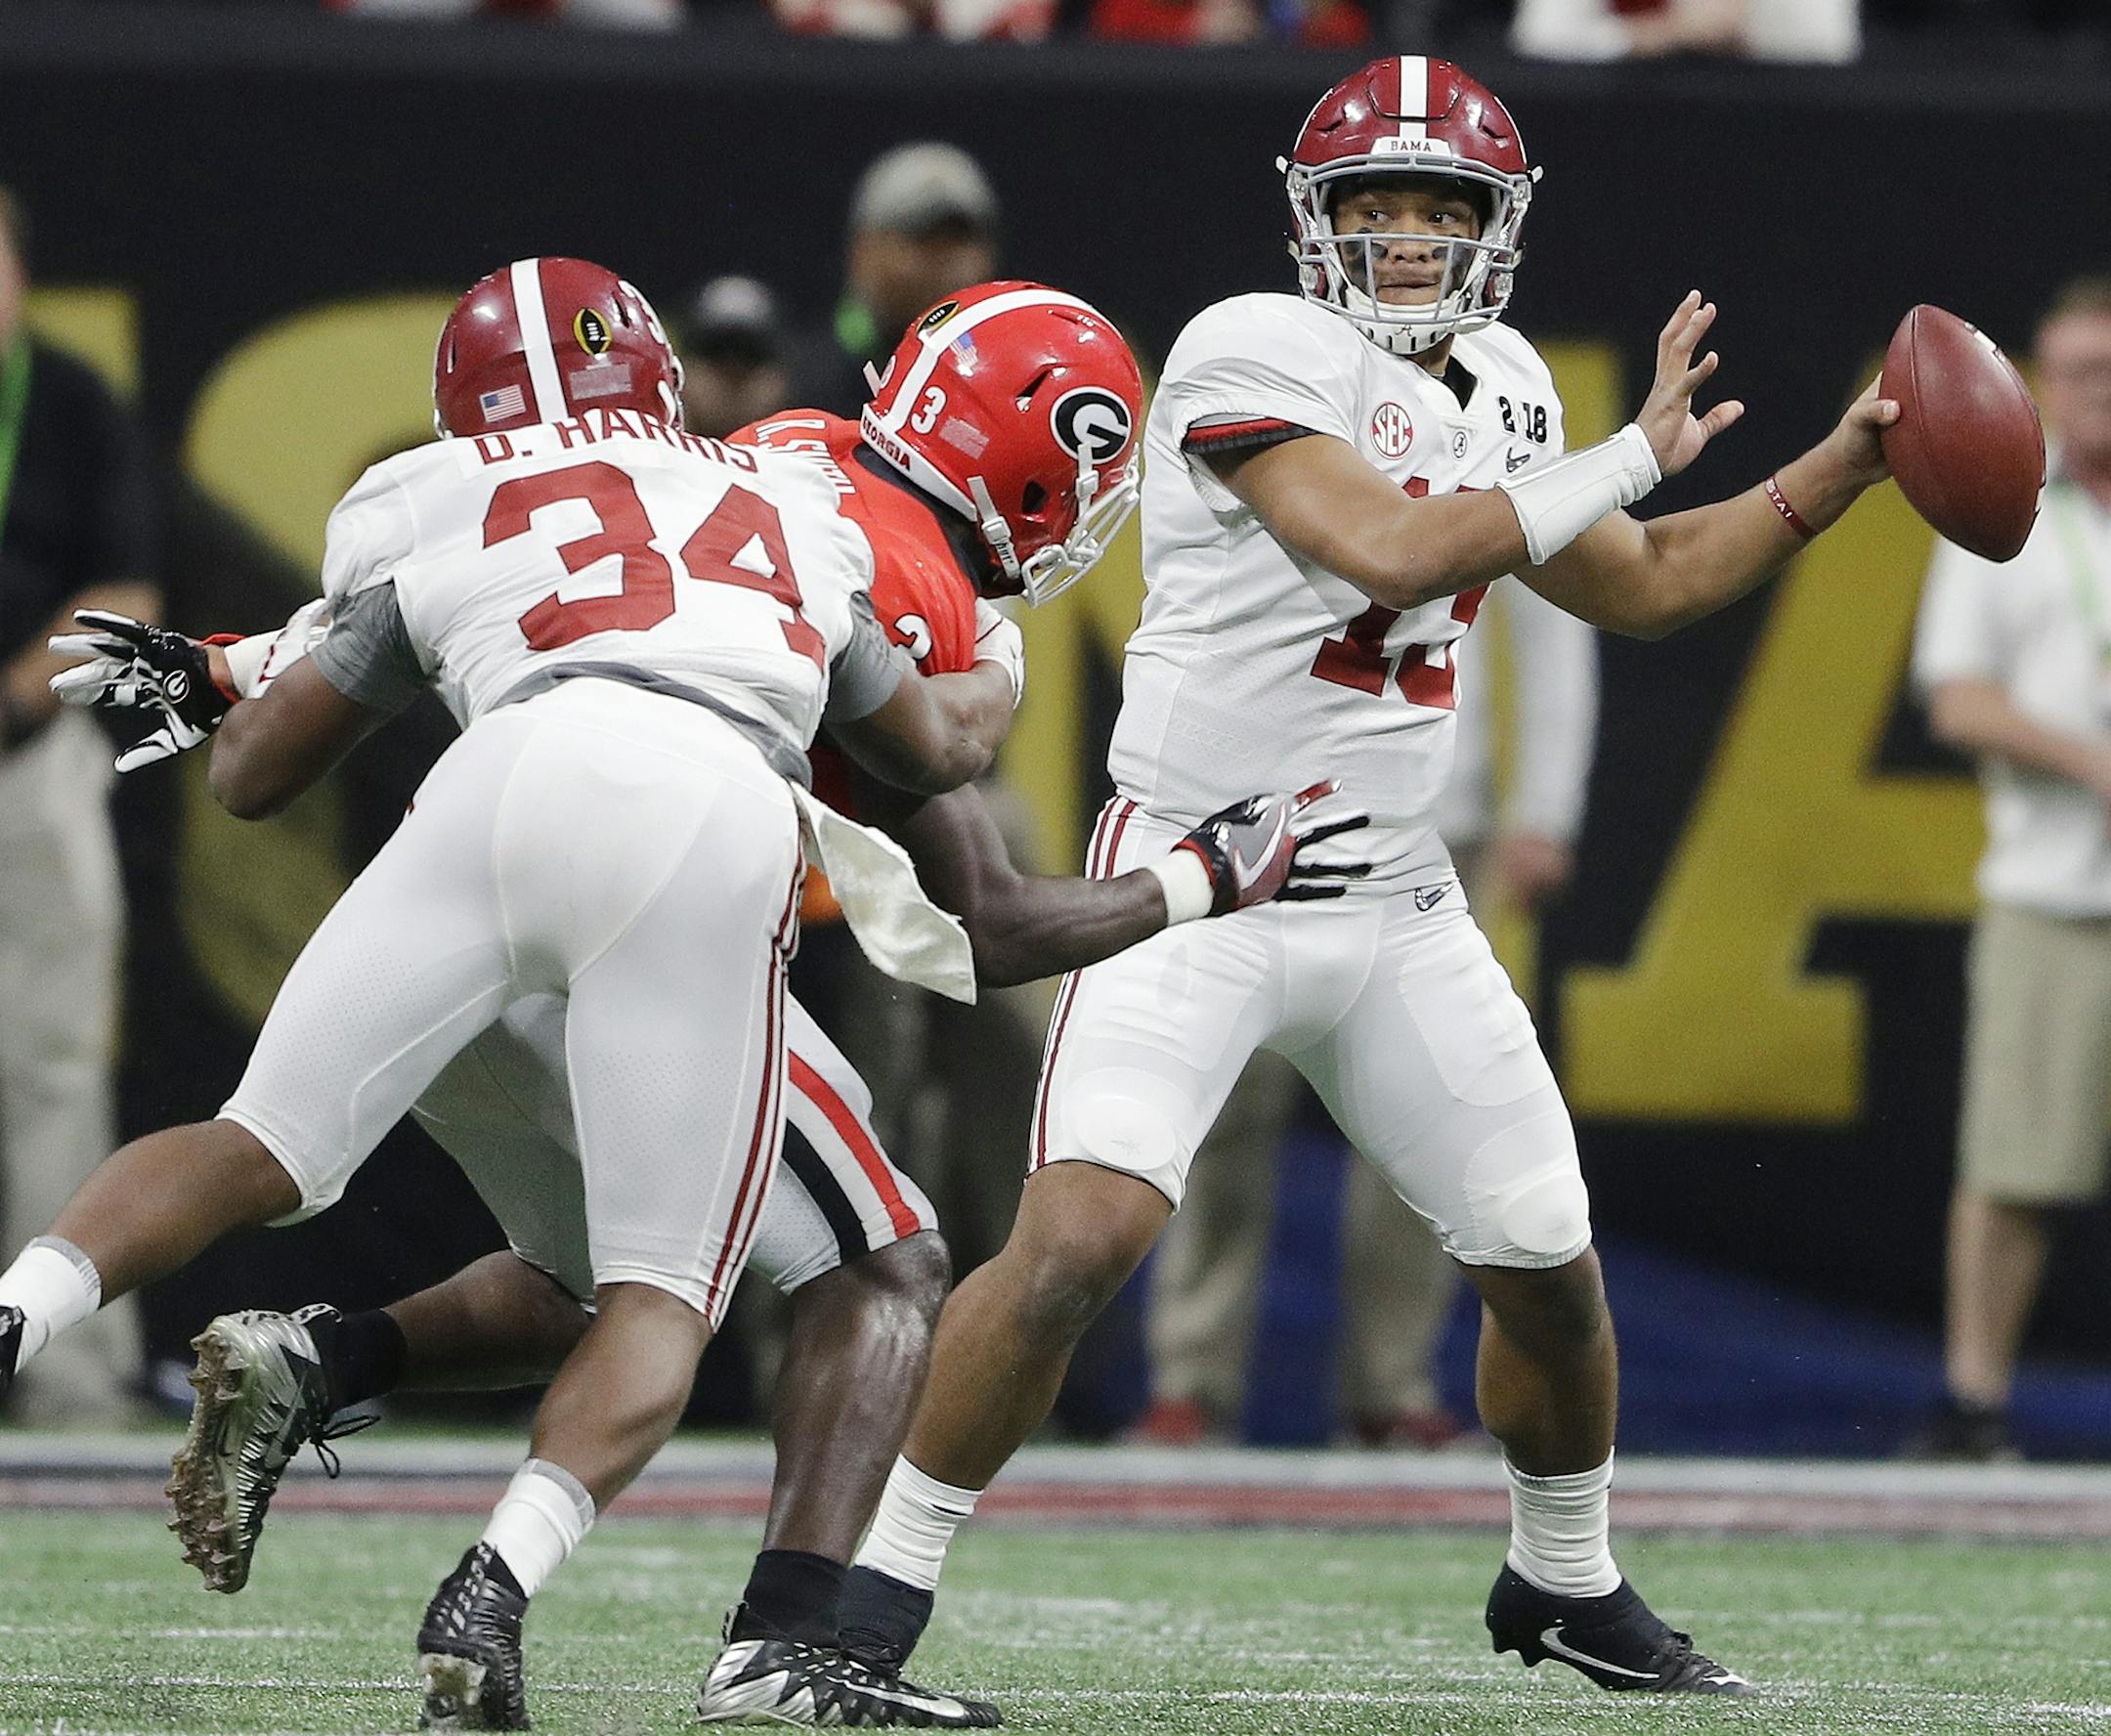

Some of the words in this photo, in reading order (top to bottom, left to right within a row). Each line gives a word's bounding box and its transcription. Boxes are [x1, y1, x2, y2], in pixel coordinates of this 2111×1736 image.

[1391, 141, 1432, 152] BAMA
[910, 386, 947, 435] 3
[1053, 389, 1130, 461] G
[1372, 403, 1413, 457] SEC
[474, 433, 534, 465] D.
[482, 460, 826, 673] 34
